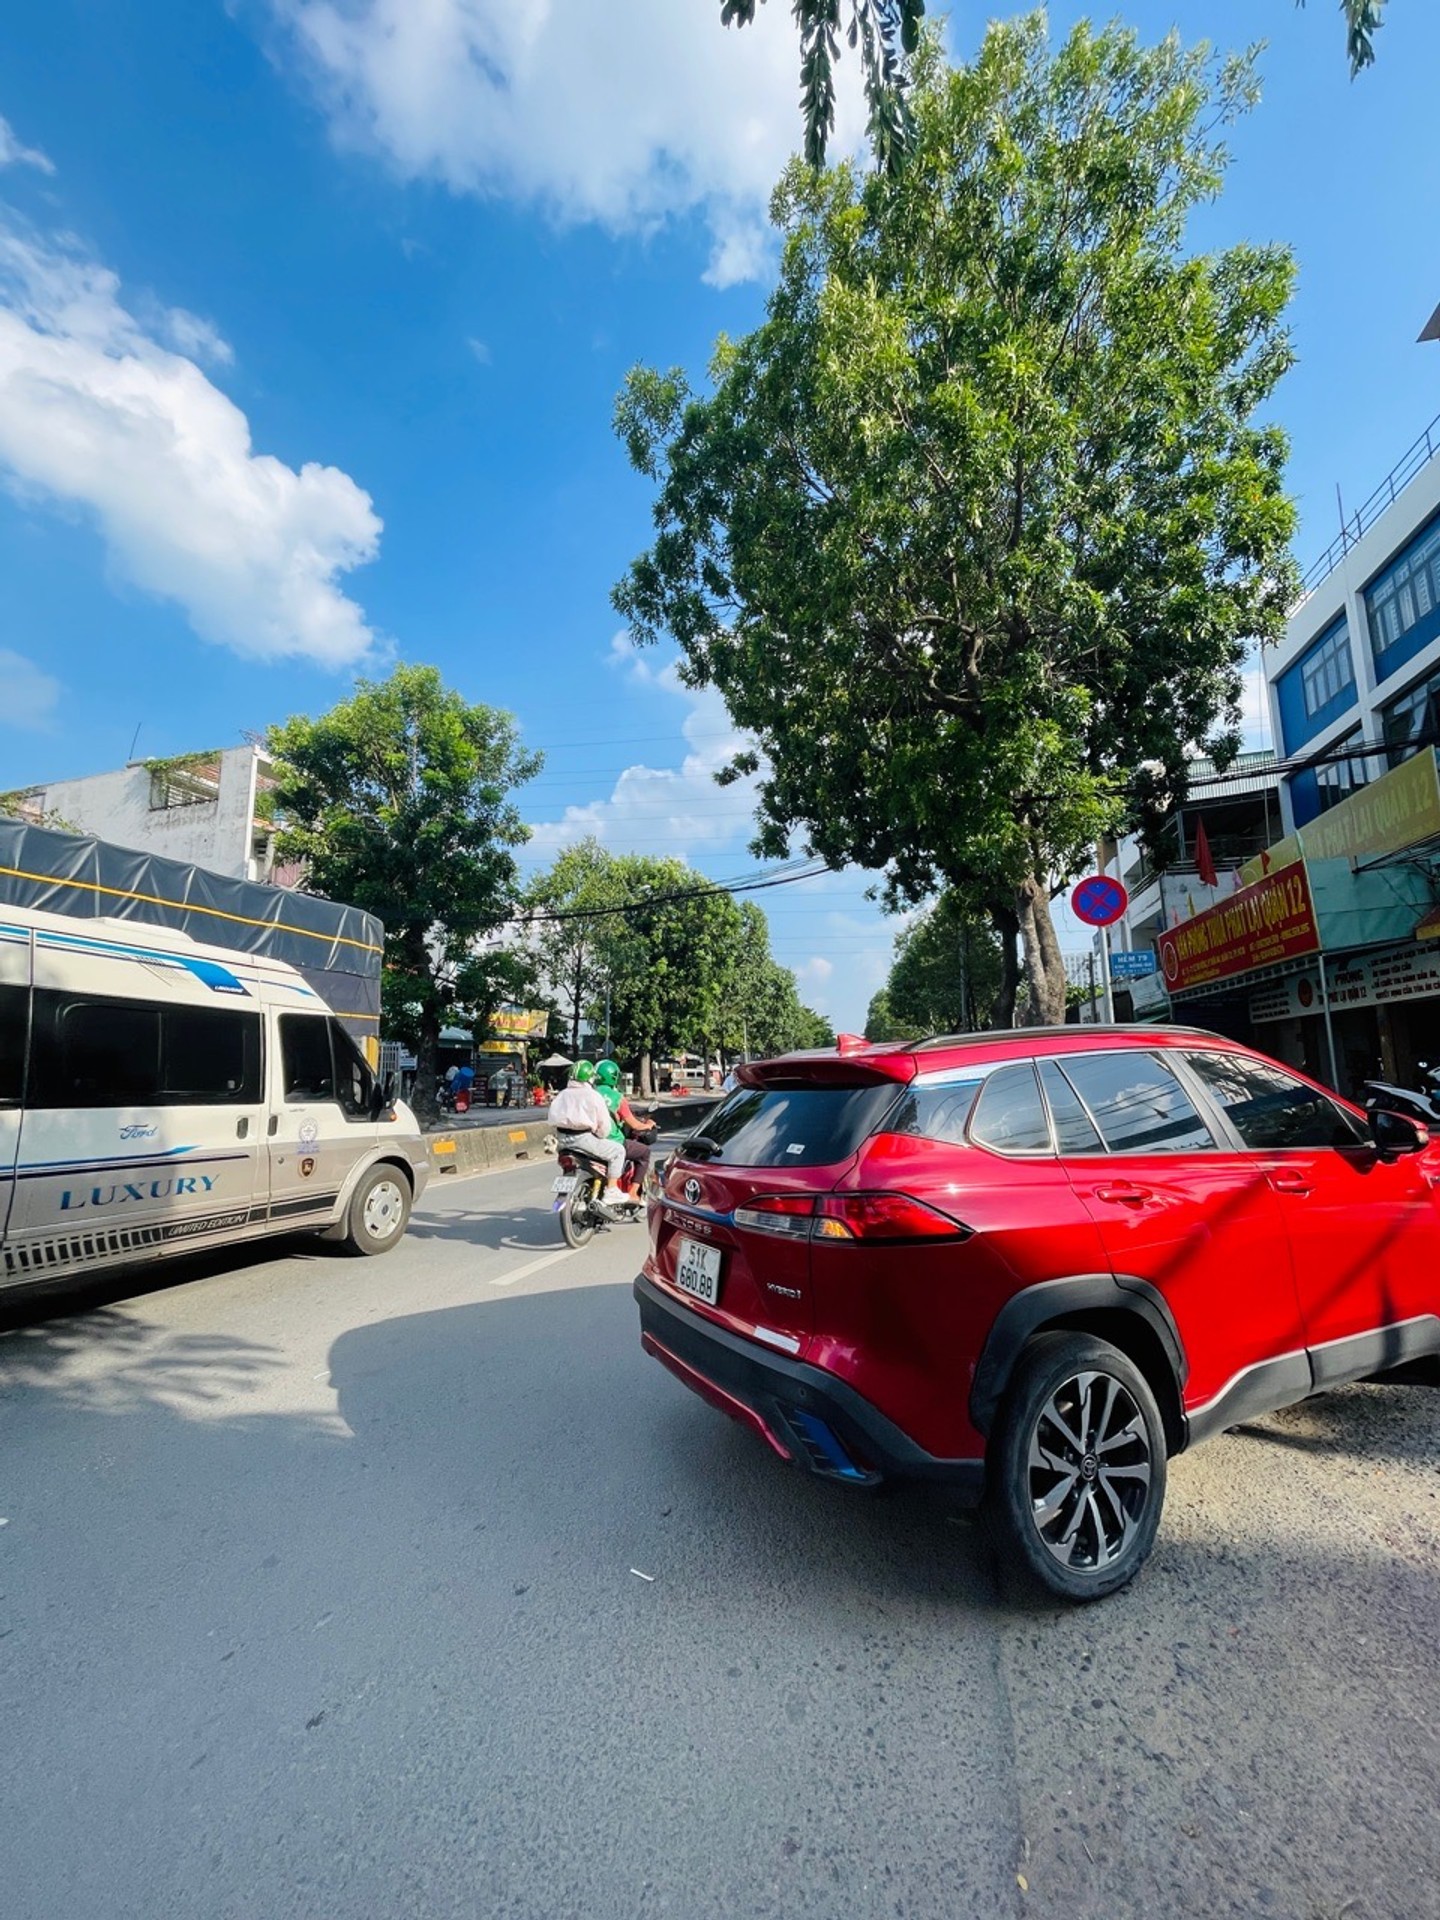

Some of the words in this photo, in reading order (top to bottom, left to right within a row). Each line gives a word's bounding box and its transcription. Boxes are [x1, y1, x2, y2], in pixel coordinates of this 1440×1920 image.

[1412, 770, 1433, 813] 12
[1260, 879, 1289, 932] QUẬN
[1287, 874, 1306, 915] 12
[119, 1124, 158, 1139] Ford
[60, 1174, 220, 1210] LUXURY
[168, 1221, 208, 1236] LIMITED
[207, 1214, 246, 1229] EDITION
[688, 1245, 708, 1271] 51K
[680, 1265, 713, 1298] 680.88
